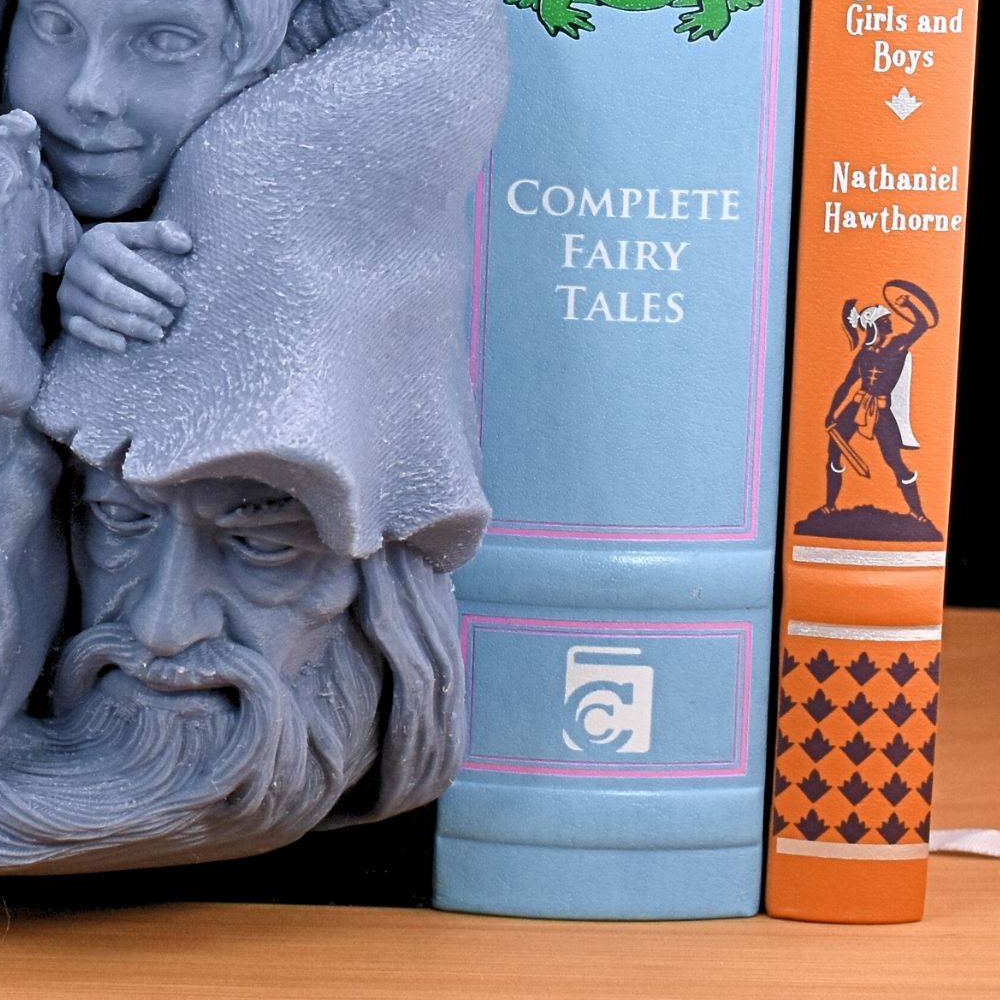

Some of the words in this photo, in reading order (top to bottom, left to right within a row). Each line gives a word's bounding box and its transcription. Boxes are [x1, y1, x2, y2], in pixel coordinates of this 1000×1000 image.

[846, 3, 908, 36] Girls
[917, 7, 964, 33] and
[873, 40, 935, 74] Boys
[832, 160, 958, 194] Nathaniel
[507, 178, 740, 221] COMPLETE
[824, 201, 963, 234] Hawthorne
[560, 233, 691, 272] FAIRY
[554, 284, 685, 324] TALES
